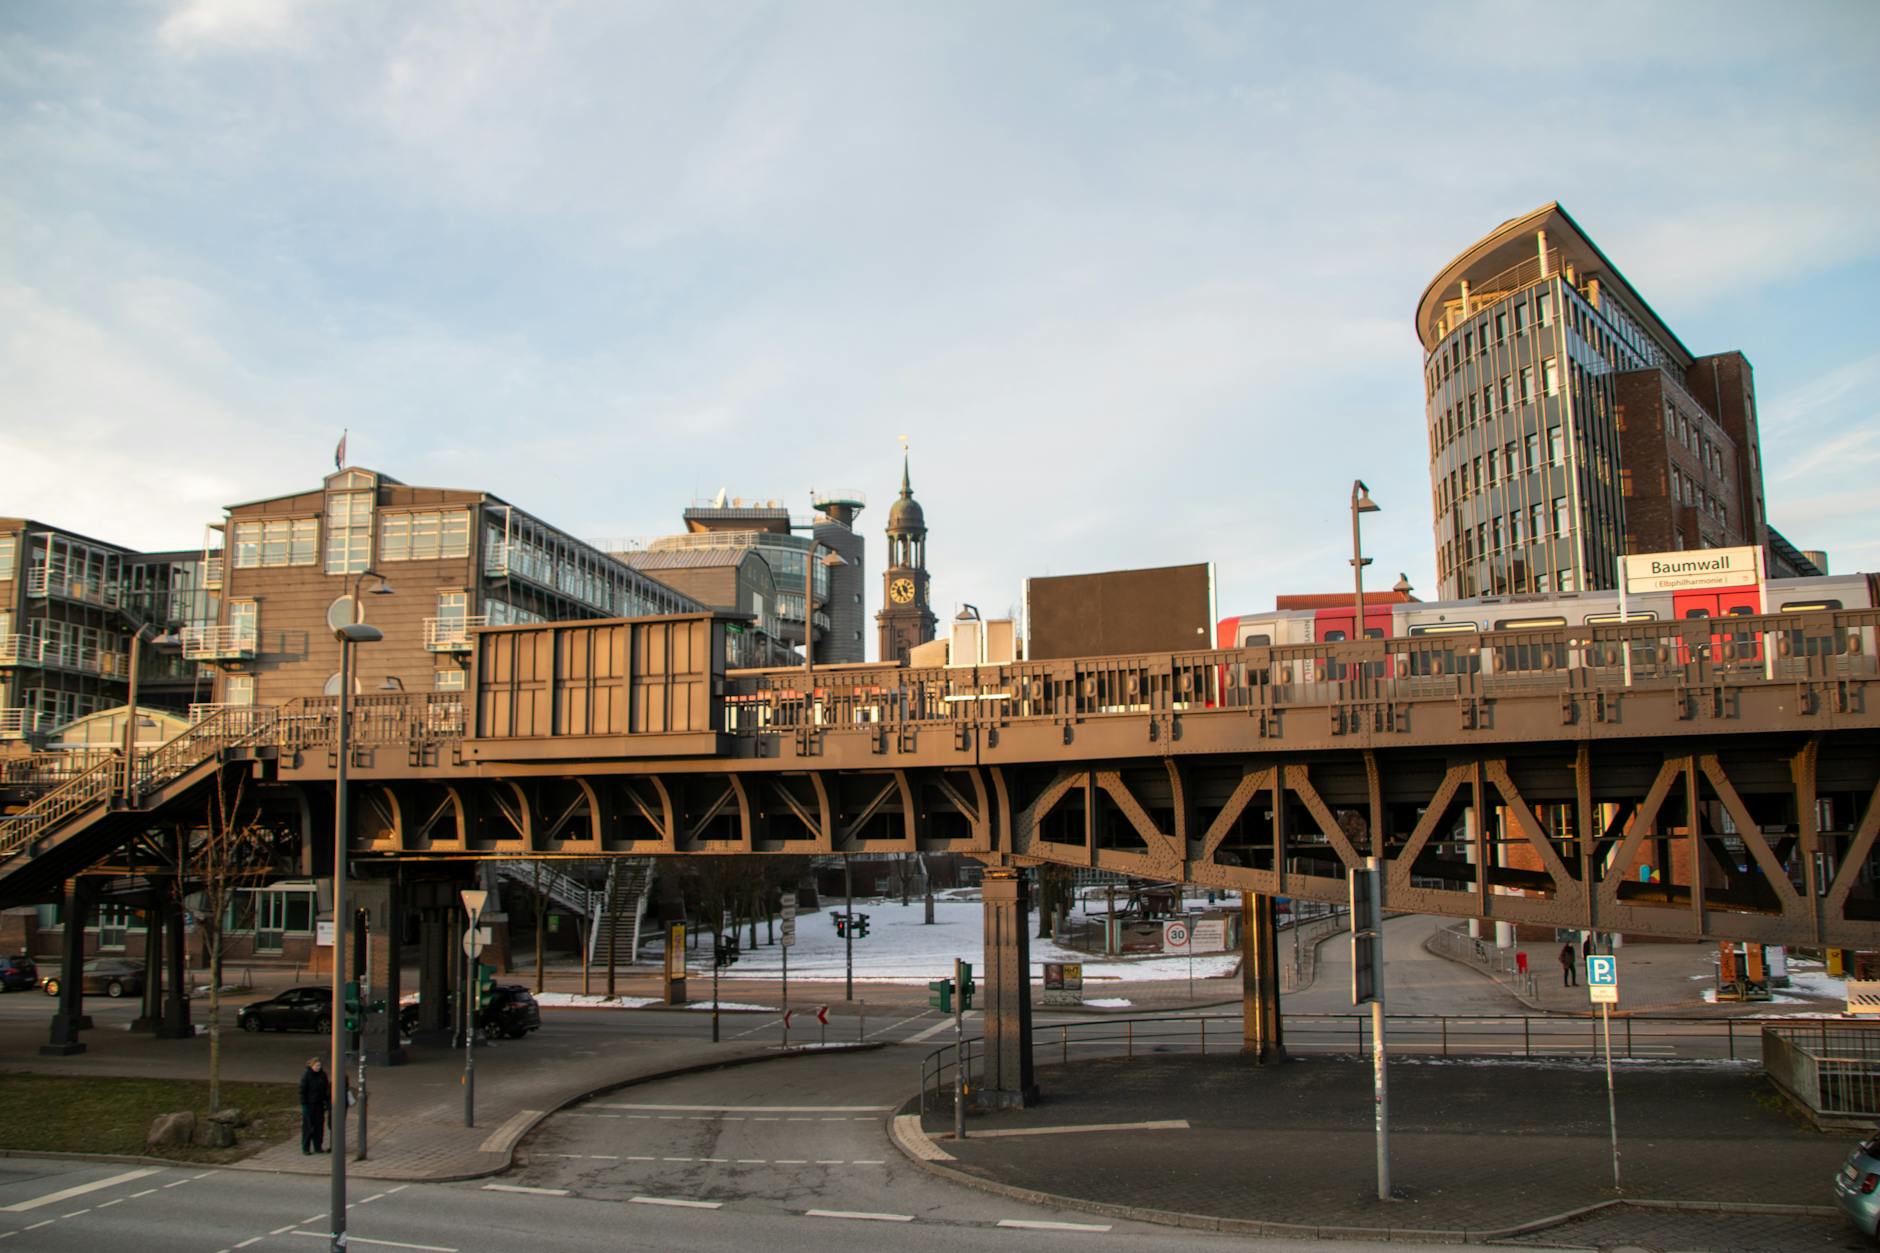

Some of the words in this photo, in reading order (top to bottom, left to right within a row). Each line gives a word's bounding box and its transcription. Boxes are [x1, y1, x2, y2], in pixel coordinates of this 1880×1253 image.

[1651, 555, 1730, 574] Baumwall
[1170, 929, 1185, 939] 30
[1593, 959, 1610, 982] P
